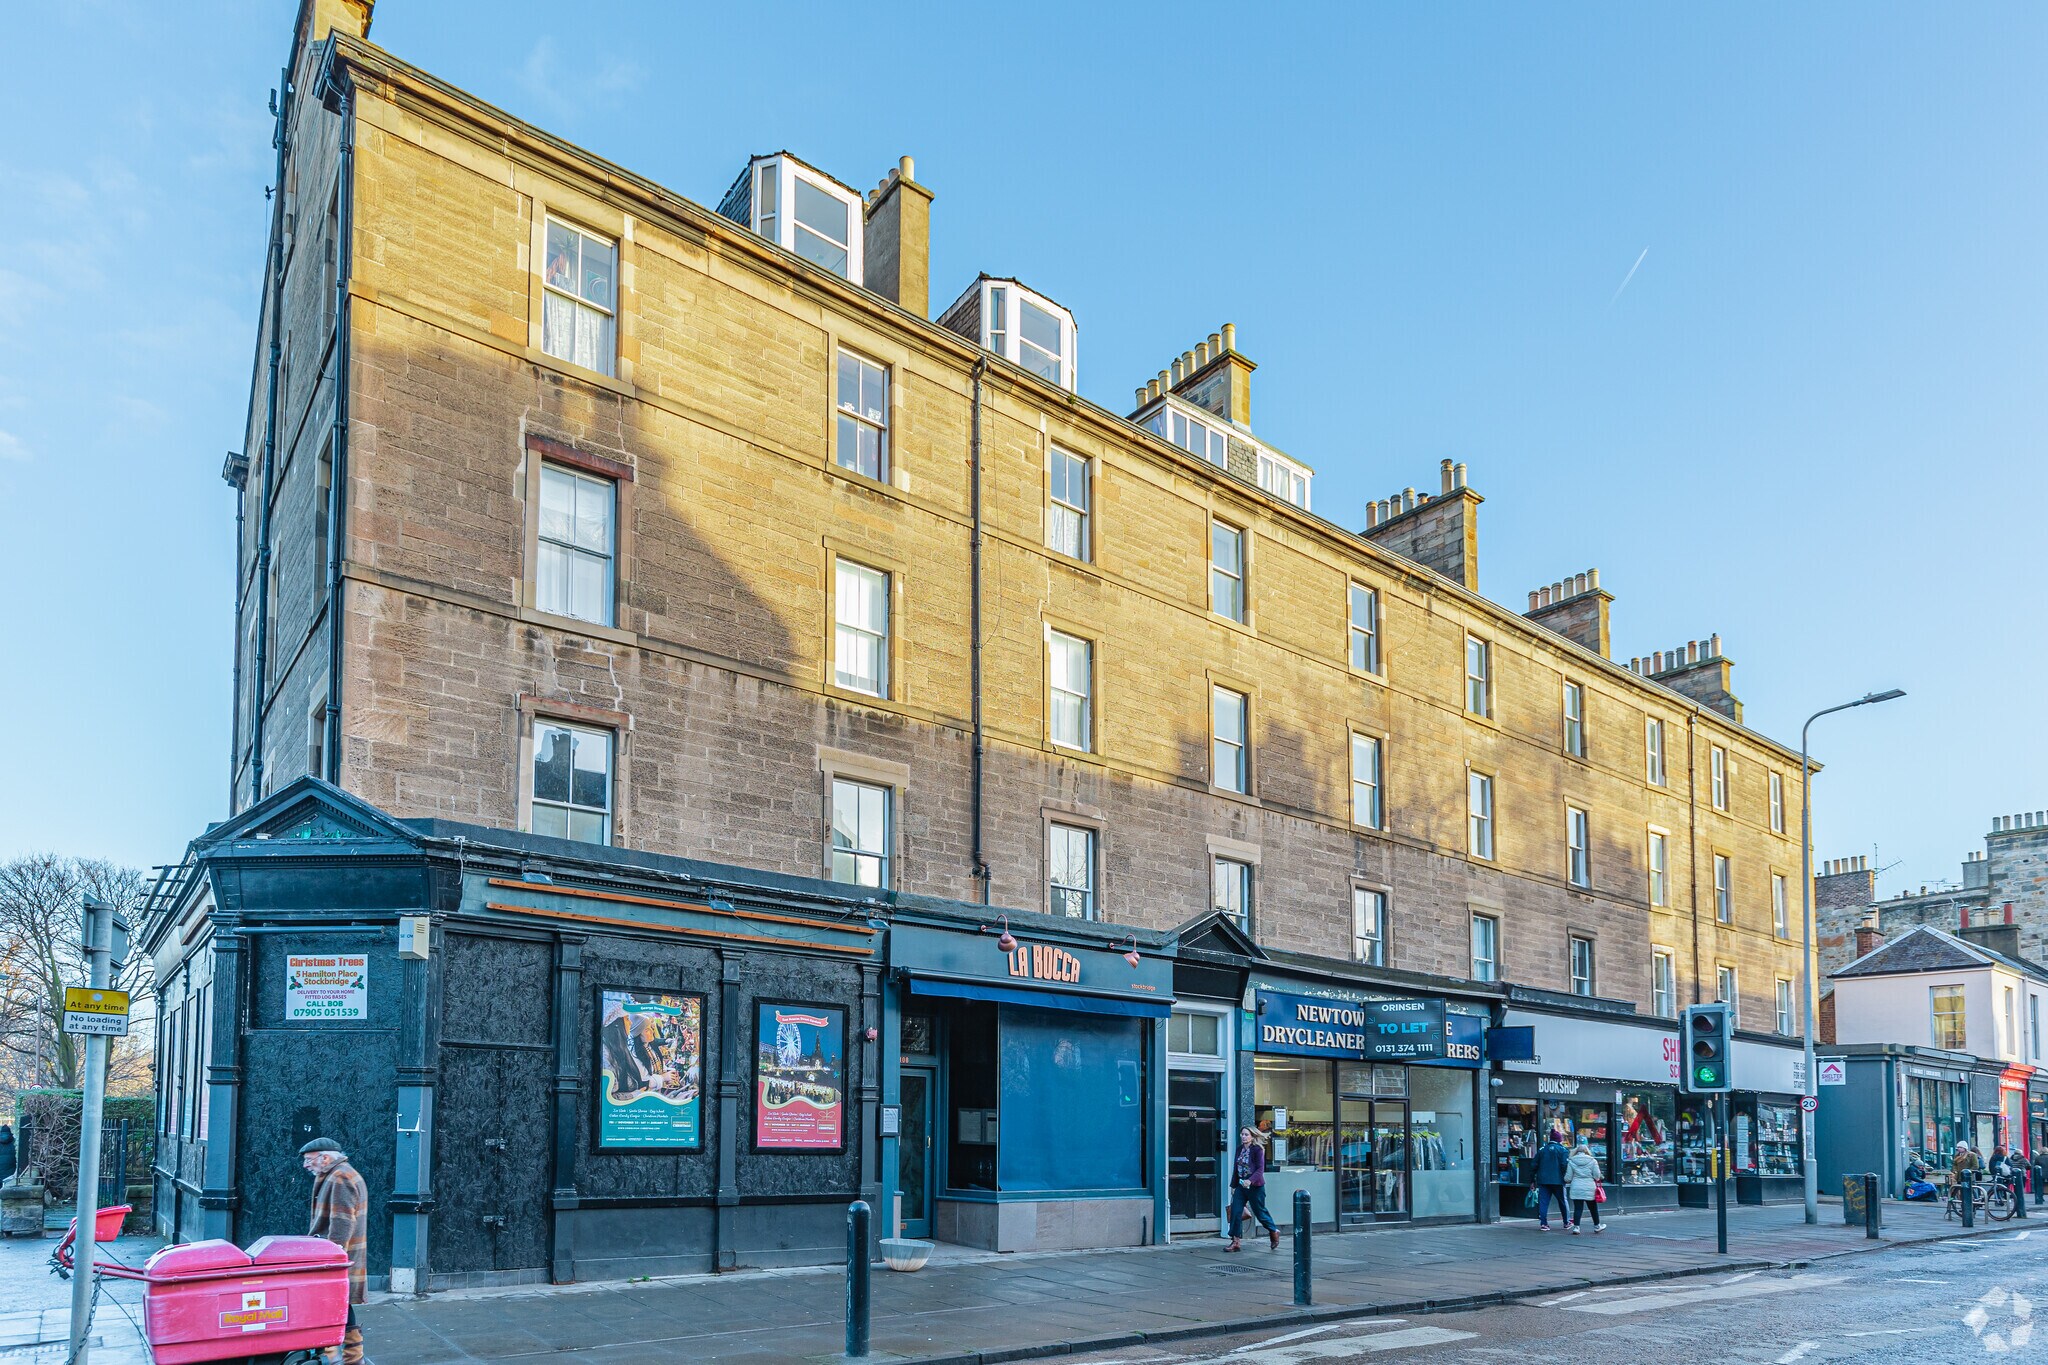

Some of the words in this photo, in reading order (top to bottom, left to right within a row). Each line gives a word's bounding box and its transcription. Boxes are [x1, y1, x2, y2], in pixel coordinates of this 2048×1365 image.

[290, 958, 336, 967] Christmas
[338, 957, 364, 966] Trees
[1008, 946, 1028, 977] LA
[1032, 944, 1080, 982] BOCCA
[304, 978, 350, 986] Stockbridge
[1382, 1003, 1424, 1011] ORINSEN
[88, 1016, 121, 1025] loading
[1296, 1004, 1364, 1027] NEWTOW
[1378, 1023, 1398, 1034] TO
[1402, 1022, 1429, 1033] LET
[1262, 1024, 1364, 1050] DRYCLEANER
[1447, 1042, 1480, 1060] RERS
[1538, 1078, 1580, 1094] BOOKSHOP
[224, 1312, 257, 1324] Royal
[258, 1309, 283, 1320] Mail
